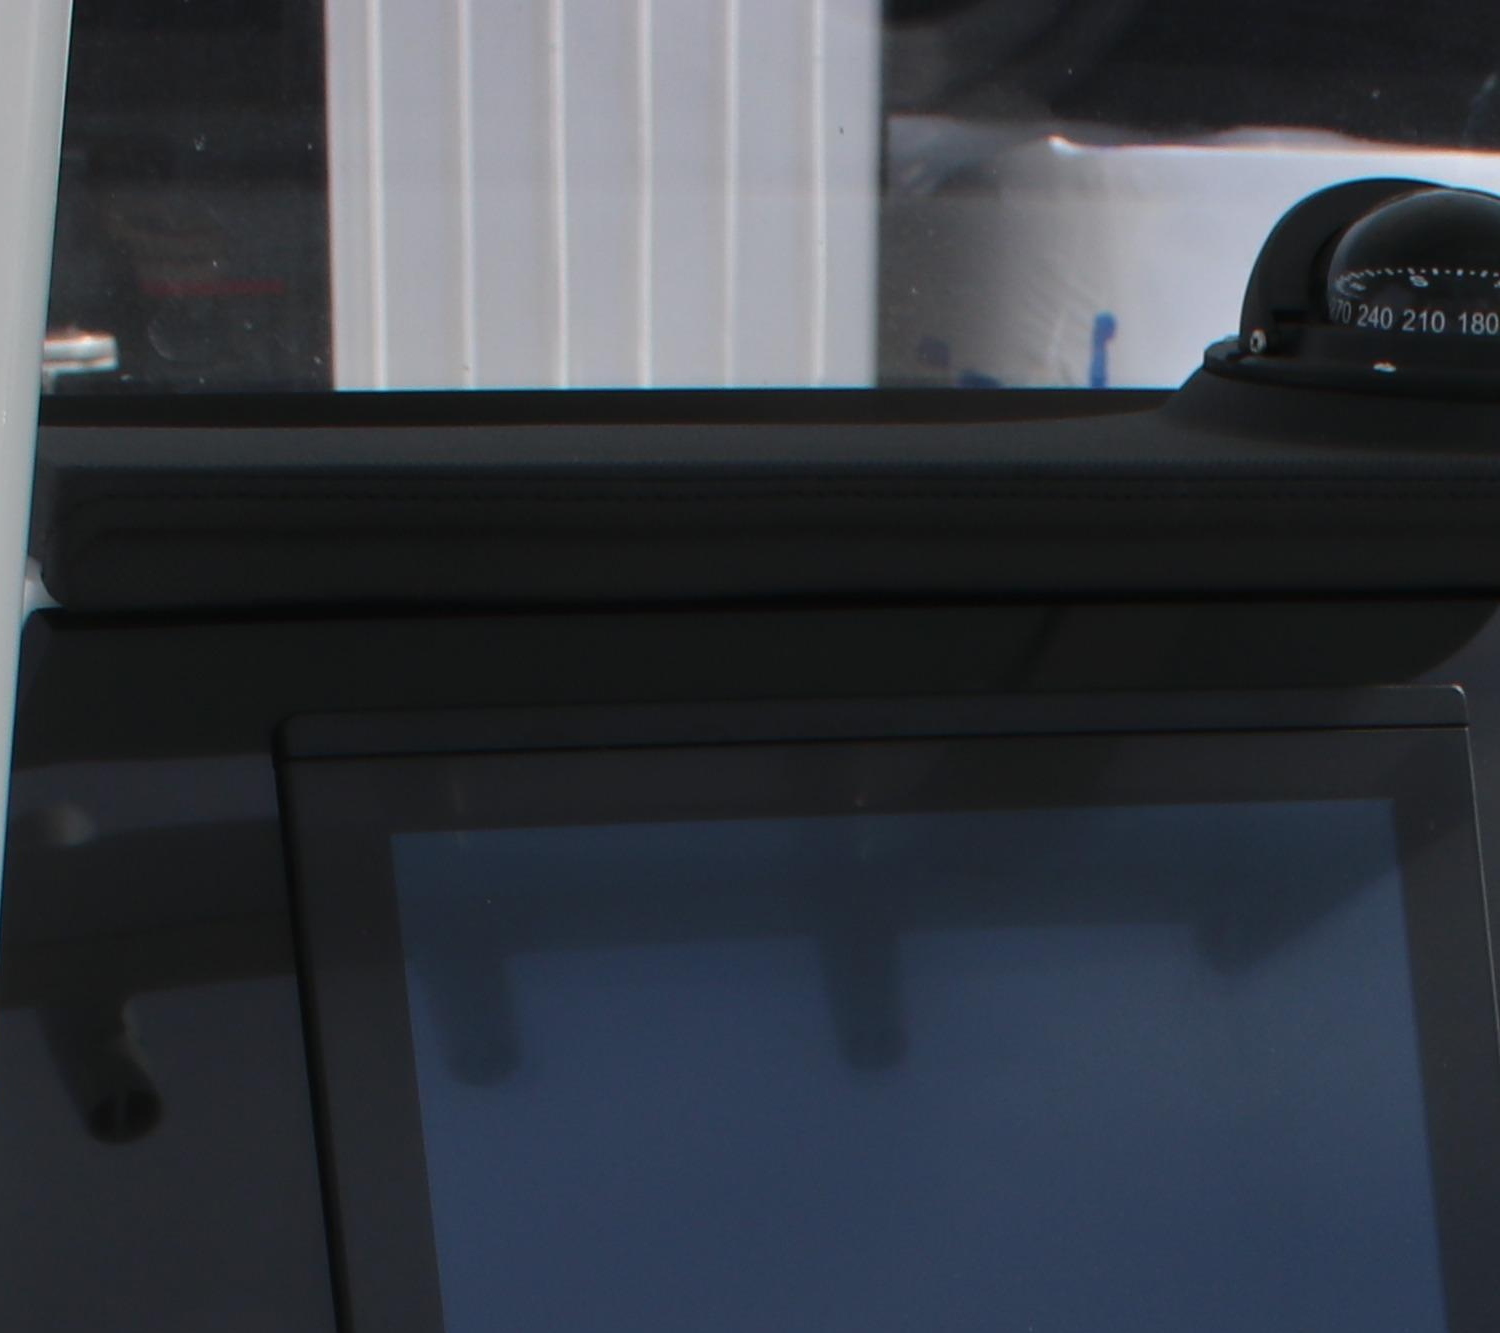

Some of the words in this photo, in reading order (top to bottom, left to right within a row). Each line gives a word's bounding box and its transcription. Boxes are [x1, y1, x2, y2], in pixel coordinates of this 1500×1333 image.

[1357, 304, 1393, 329] 240
[1402, 308, 1446, 333] 210
[1459, 312, 1498, 335] 180
